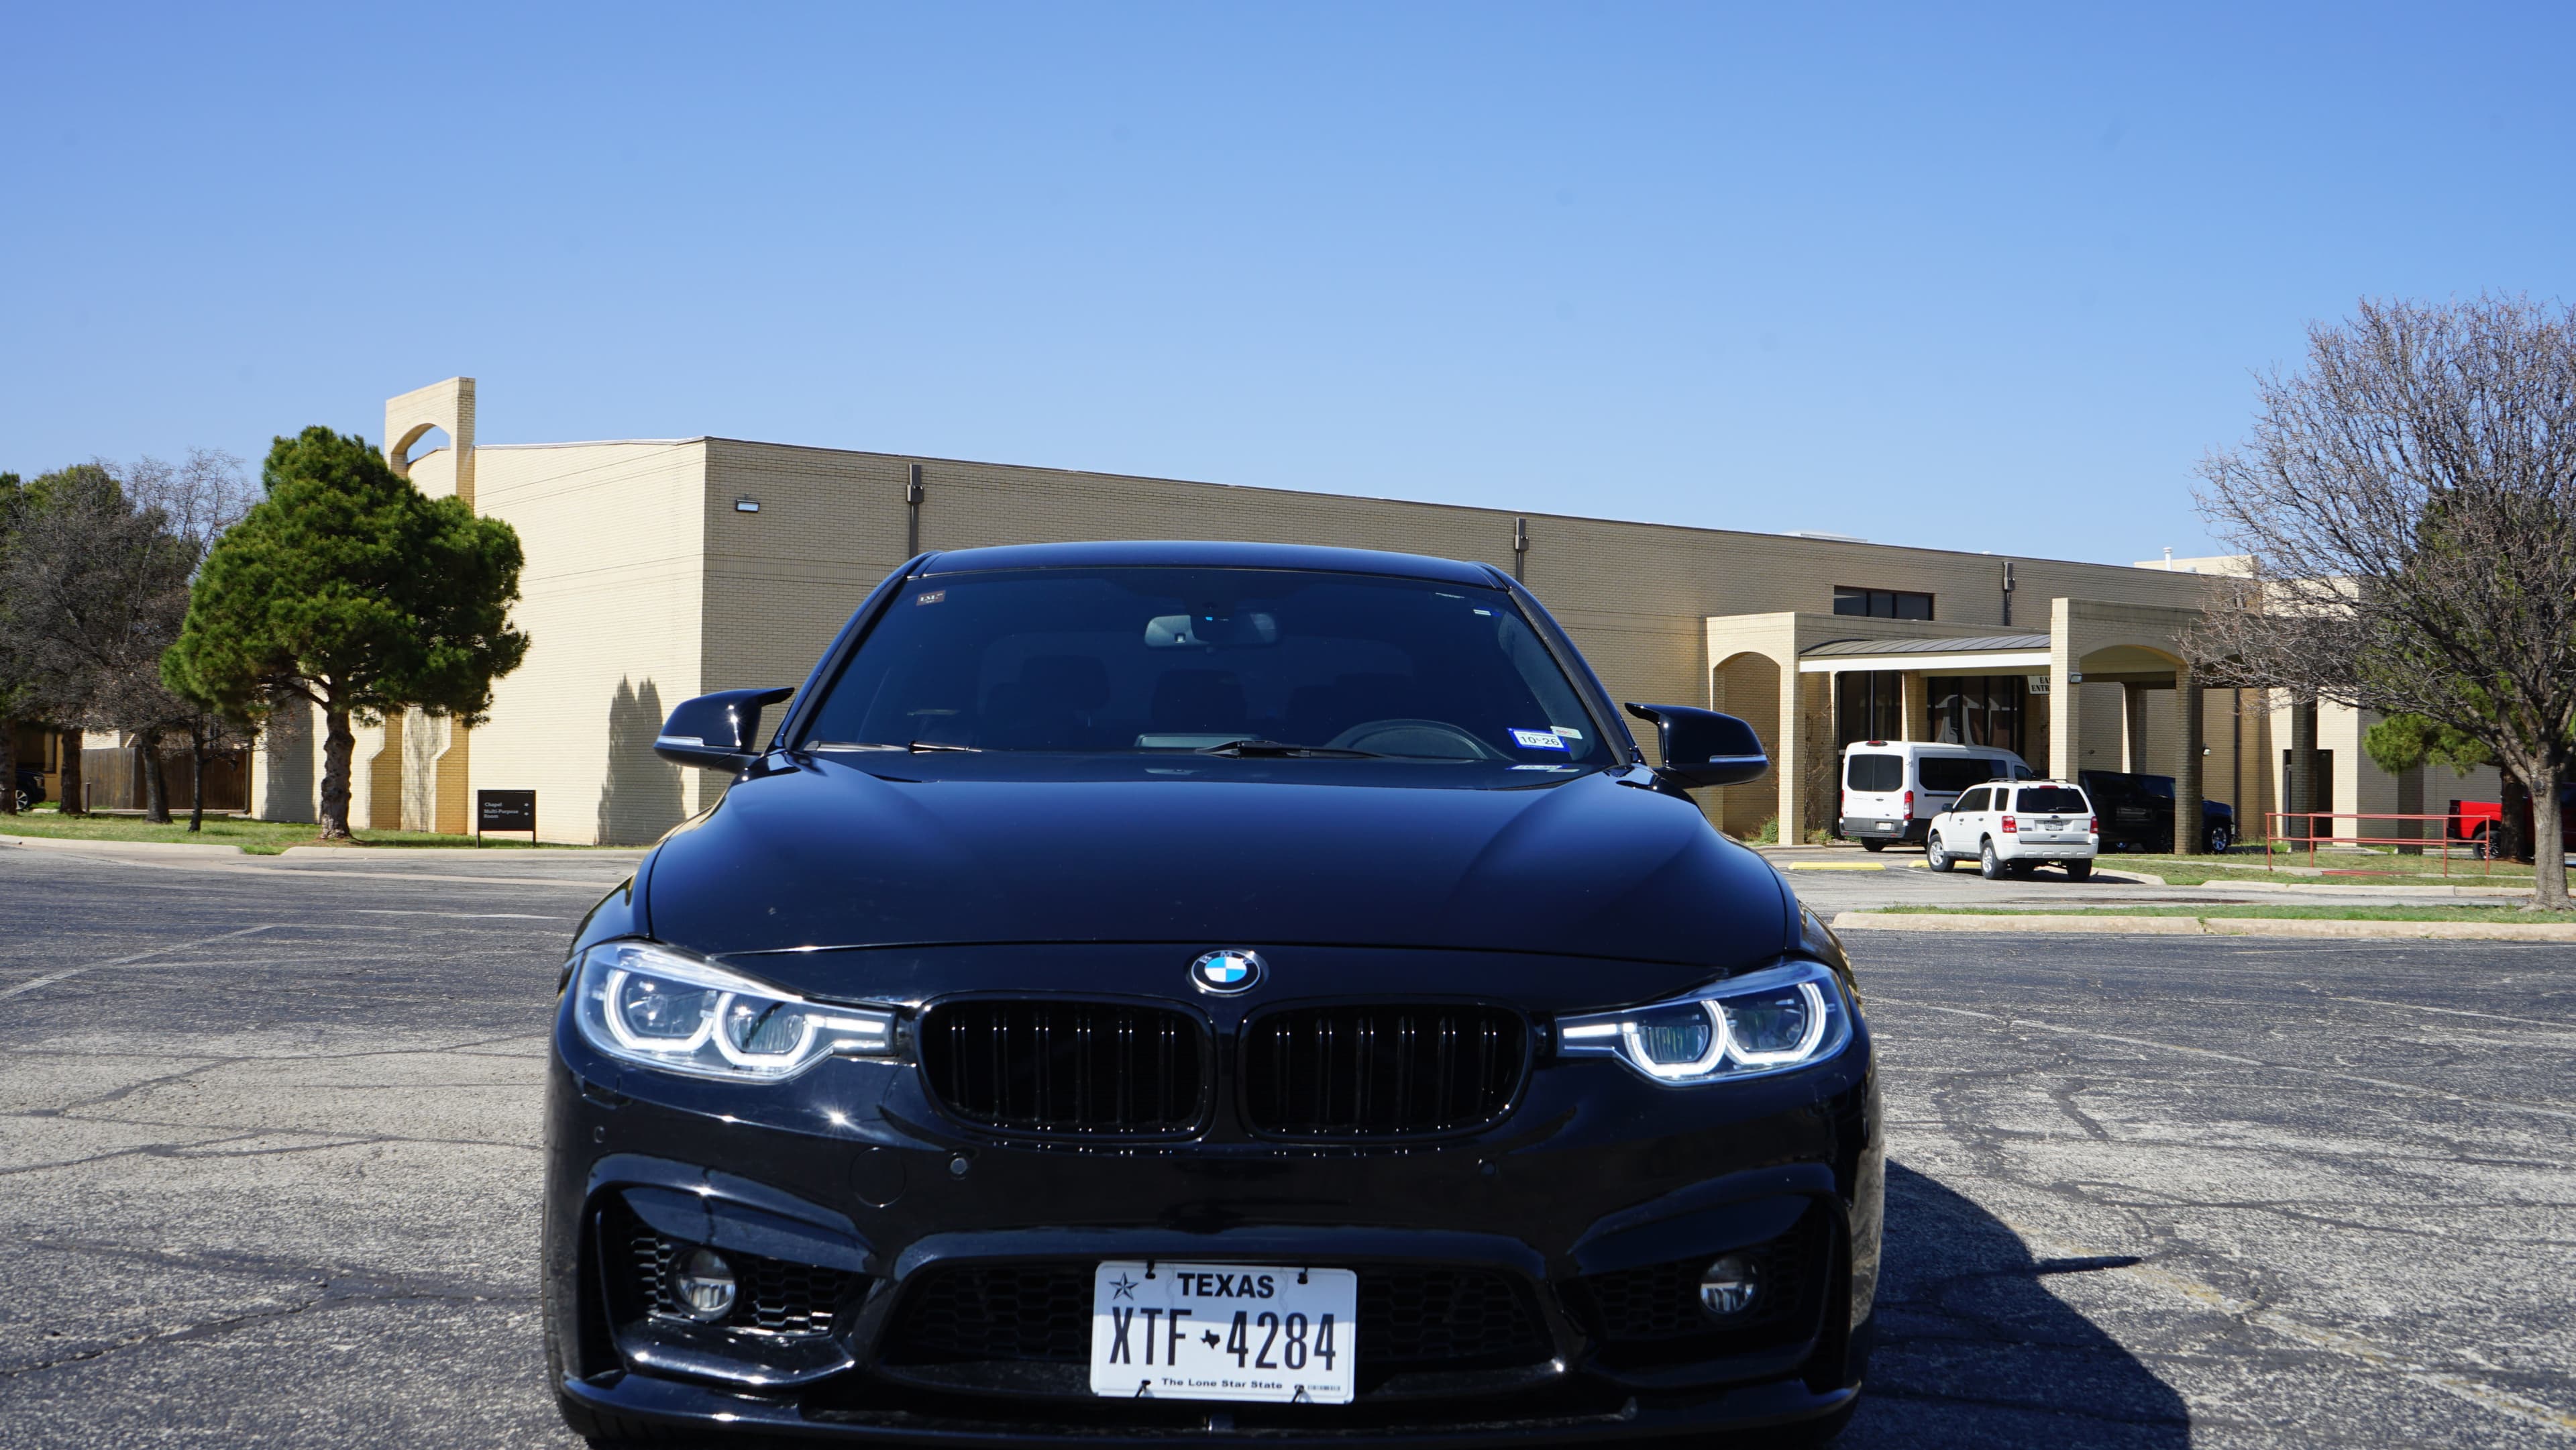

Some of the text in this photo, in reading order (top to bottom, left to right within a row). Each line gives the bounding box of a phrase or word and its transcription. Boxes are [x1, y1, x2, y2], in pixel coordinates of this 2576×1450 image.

[1198, 951, 1255, 964] BMW
[1177, 1272, 1275, 1299] TEXAS
[1108, 1306, 1336, 1371] XTF 4284
[1161, 1378, 1283, 1390] The Lone Star State
